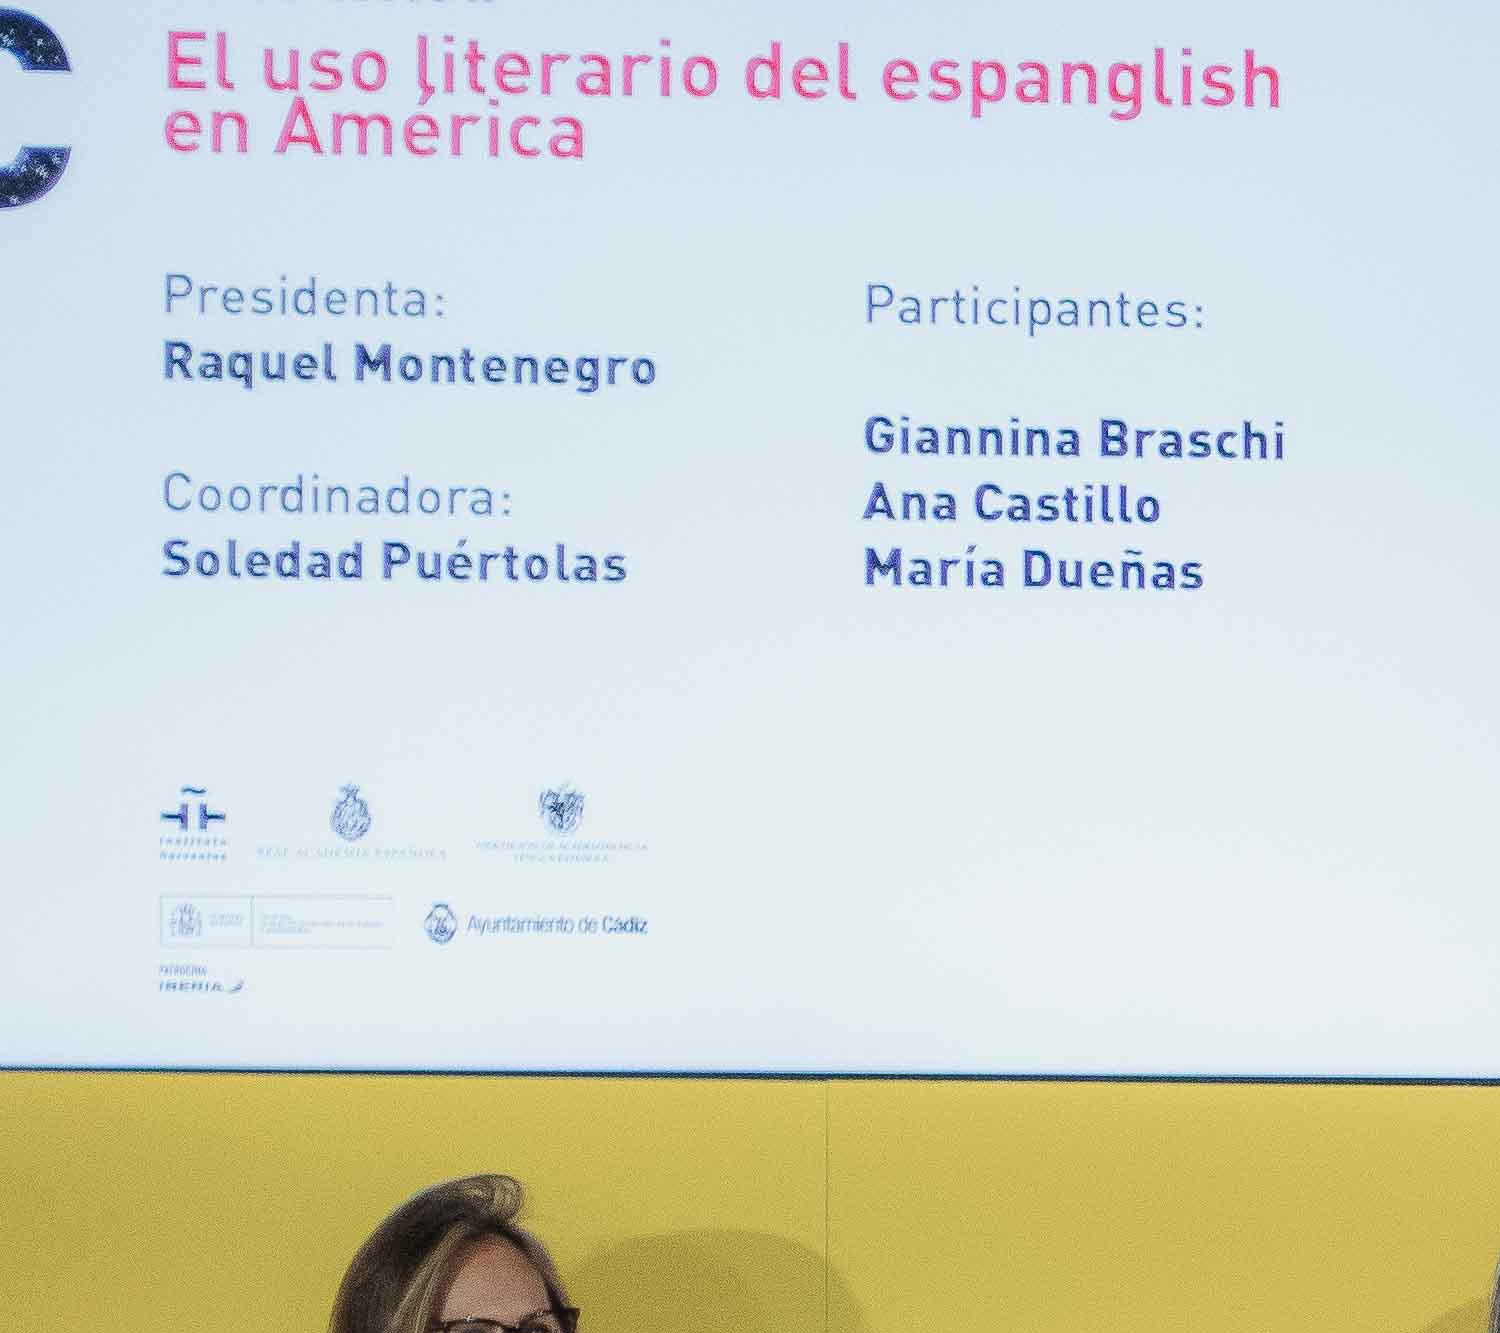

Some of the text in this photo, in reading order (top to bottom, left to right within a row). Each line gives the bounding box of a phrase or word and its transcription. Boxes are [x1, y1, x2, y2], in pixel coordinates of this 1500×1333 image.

[168, 30, 1280, 121] El uso literario del espanglish
[164, 93, 586, 160] en América
[165, 273, 443, 318] Presidenta:
[867, 283, 1202, 337] Participantes:
[165, 340, 655, 394] Raquel Montenegro
[865, 416, 1283, 460] Giannina Braschi
[163, 471, 510, 516] Coordinadora:
[863, 482, 1160, 523] Ana Castillo
[163, 539, 627, 582] Soledad Puértolas
[866, 545, 1203, 590] María Dueñas
